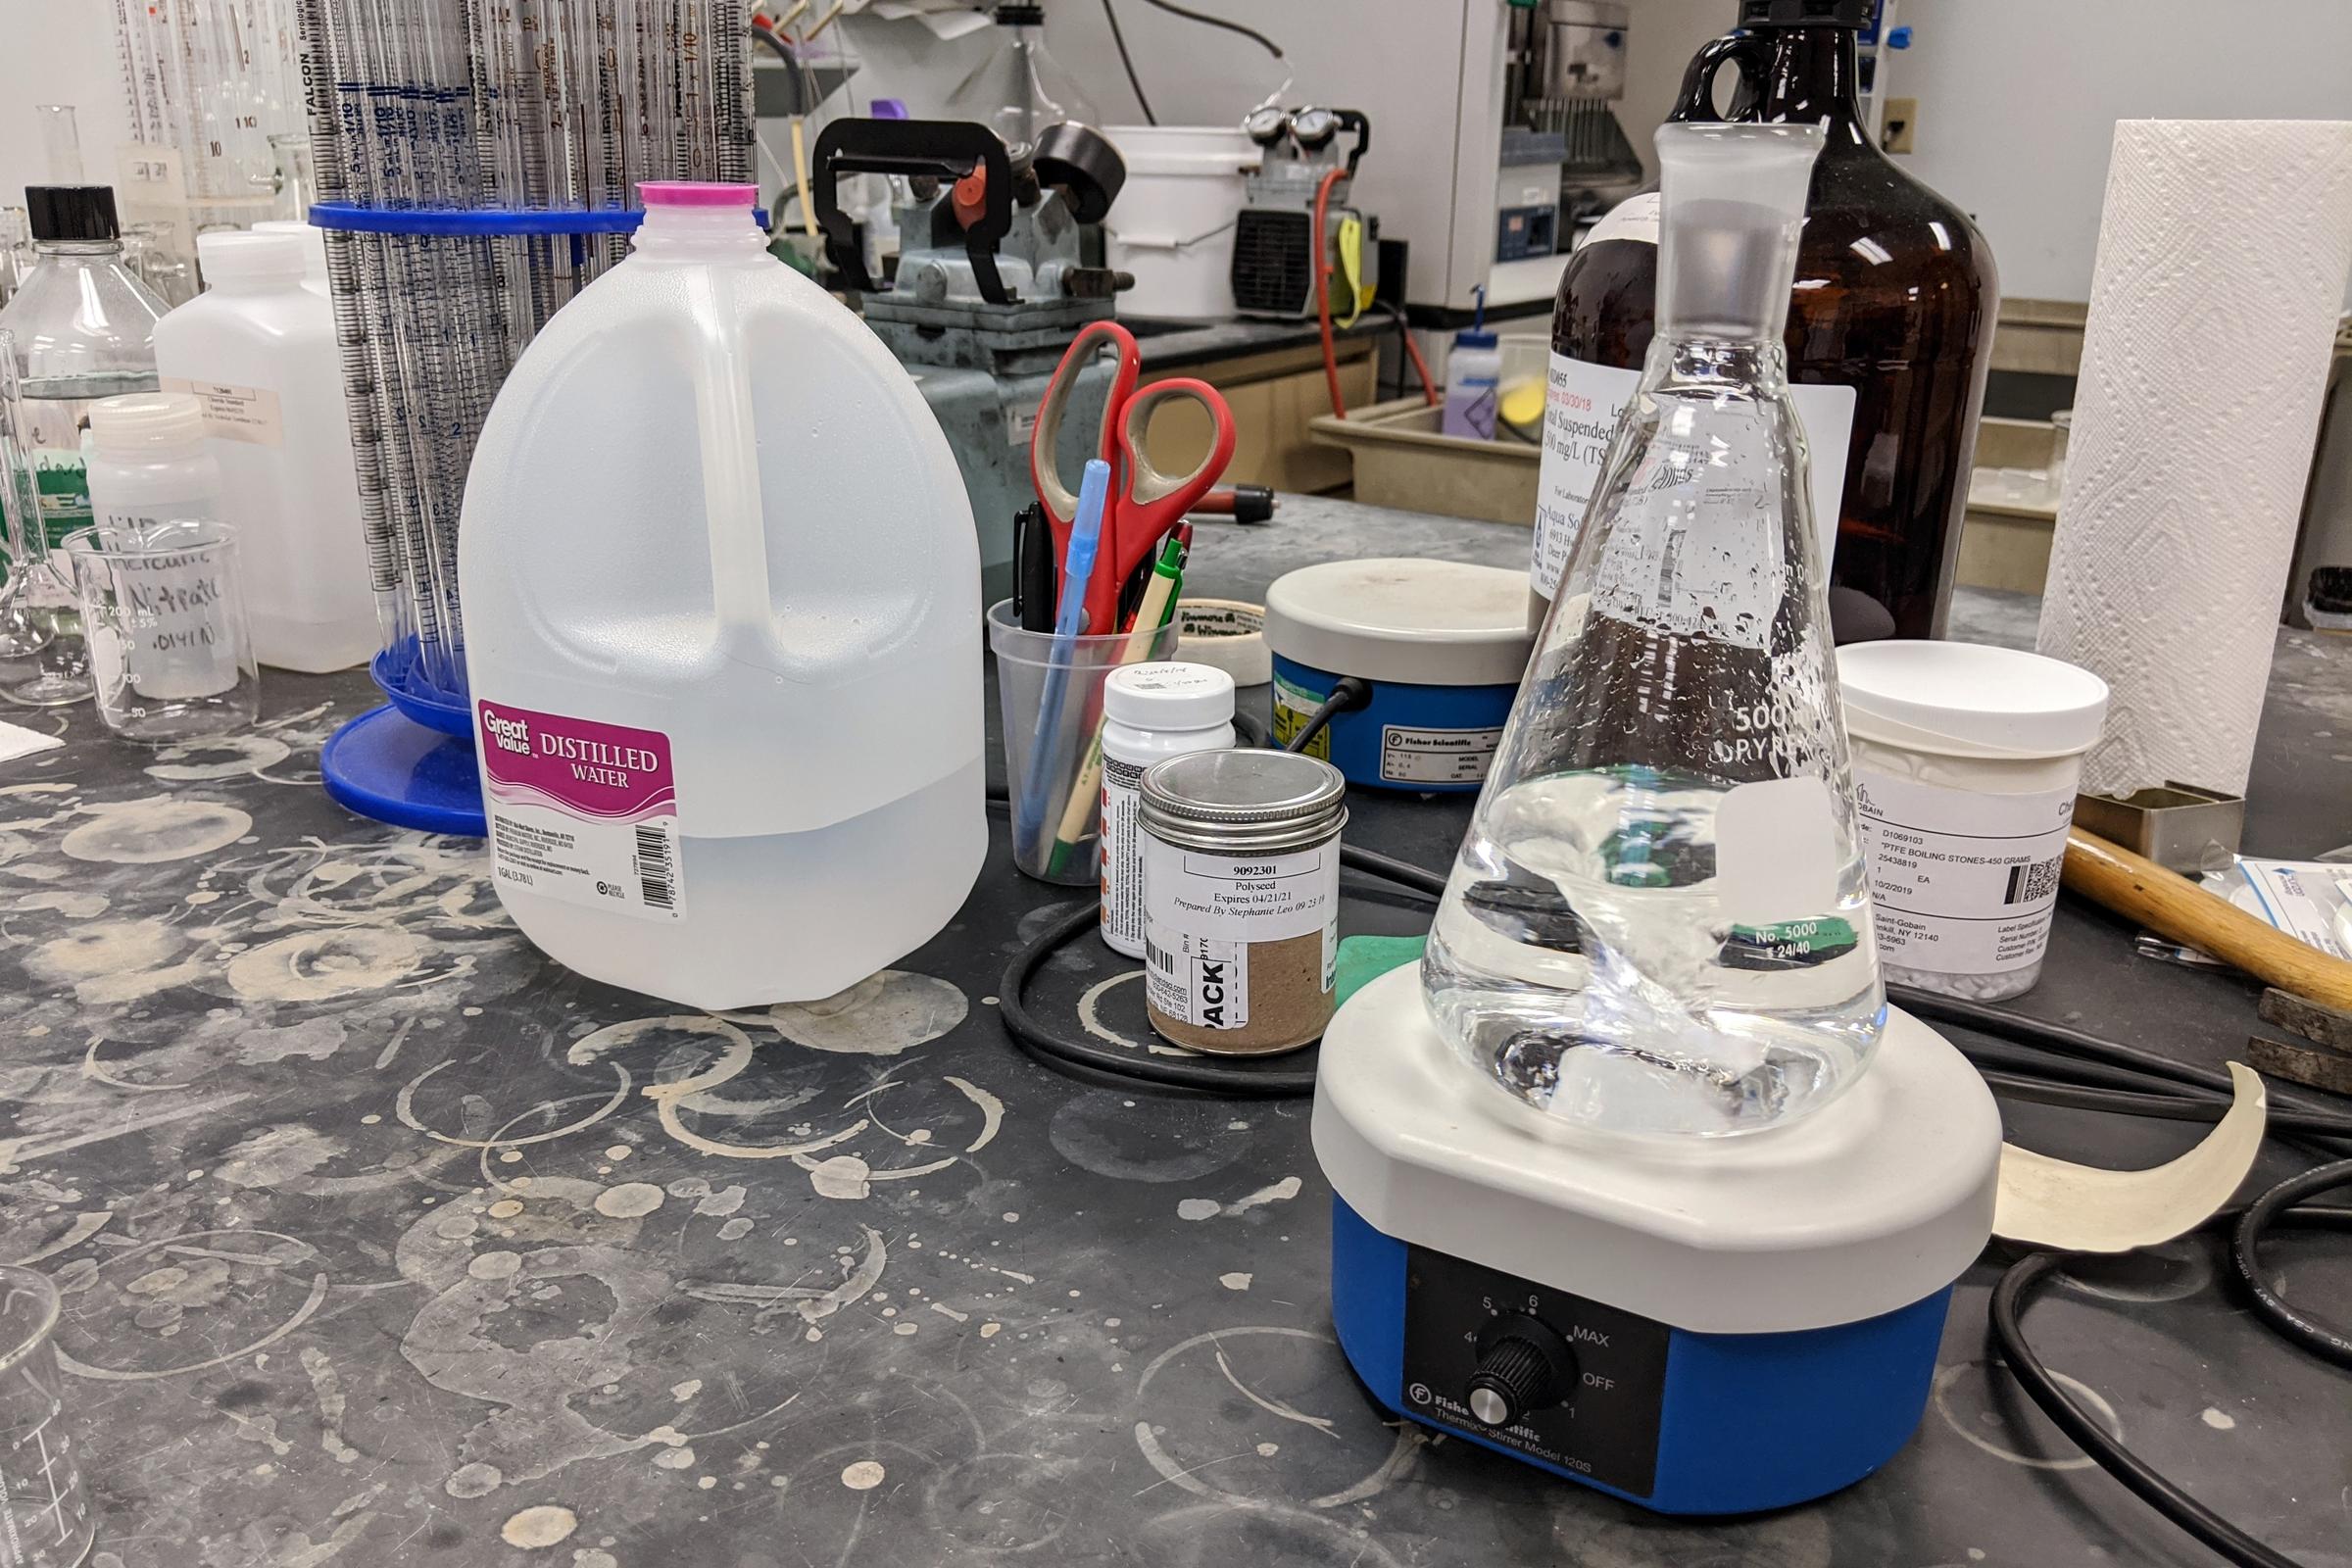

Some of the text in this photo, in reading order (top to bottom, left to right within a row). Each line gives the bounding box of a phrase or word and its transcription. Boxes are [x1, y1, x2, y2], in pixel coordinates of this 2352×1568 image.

[296, 0, 307, 41] Serologic
[300, 53, 317, 116] FALCON
[342, 102, 356, 134] 1/10
[452, 422, 461, 436] 2
[1558, 411, 1615, 442] Suspended
[1557, 441, 1580, 461] mg/L
[1562, 489, 1589, 504] Laborator
[484, 709, 529, 741] Great
[1736, 705, 1787, 731] 500
[495, 733, 531, 756] Value
[1405, 737, 1431, 746] Fisher
[539, 733, 659, 773] DISTILLED
[571, 763, 629, 788] WATER
[1883, 829, 1923, 845] D1069103
[1878, 854, 1917, 869] 25438819
[1908, 848, 1946, 862] BOILING
[1948, 854, 2002, 865] STONES-450
[2004, 855, 2031, 865] GRAMS
[1233, 865, 1276, 875] 9092301
[1235, 881, 1275, 892] Polyseed
[1874, 880, 1912, 894] 10/2/2019
[1917, 875, 1930, 884] EA
[1214, 892, 1291, 904] Expires 04/21/21
[1174, 897, 1212, 914] Prepared
[1213, 905, 1226, 917] By
[1228, 906, 1274, 918] Stephanie
[1276, 903, 1293, 915] Leo
[1875, 913, 1926, 931] Saint-Gobain
[1756, 922, 1817, 944] No. 5000
[1898, 928, 1911, 937] NY
[1914, 932, 1939, 942] 12140
[1777, 940, 1811, 958] 24/40
[1483, 1297, 1492, 1309] 5
[1528, 1295, 1539, 1307] 6
[1573, 1324, 1610, 1348] MAX
[1583, 1372, 1615, 1391] OFF
[1568, 1407, 1575, 1419] 1
[1488, 1428, 1522, 1448] Stirrer
[1525, 1440, 1561, 1463] Model
[1564, 1456, 1592, 1473] 120S
[3, 1507, 24, 1566] APPROXIMATE
